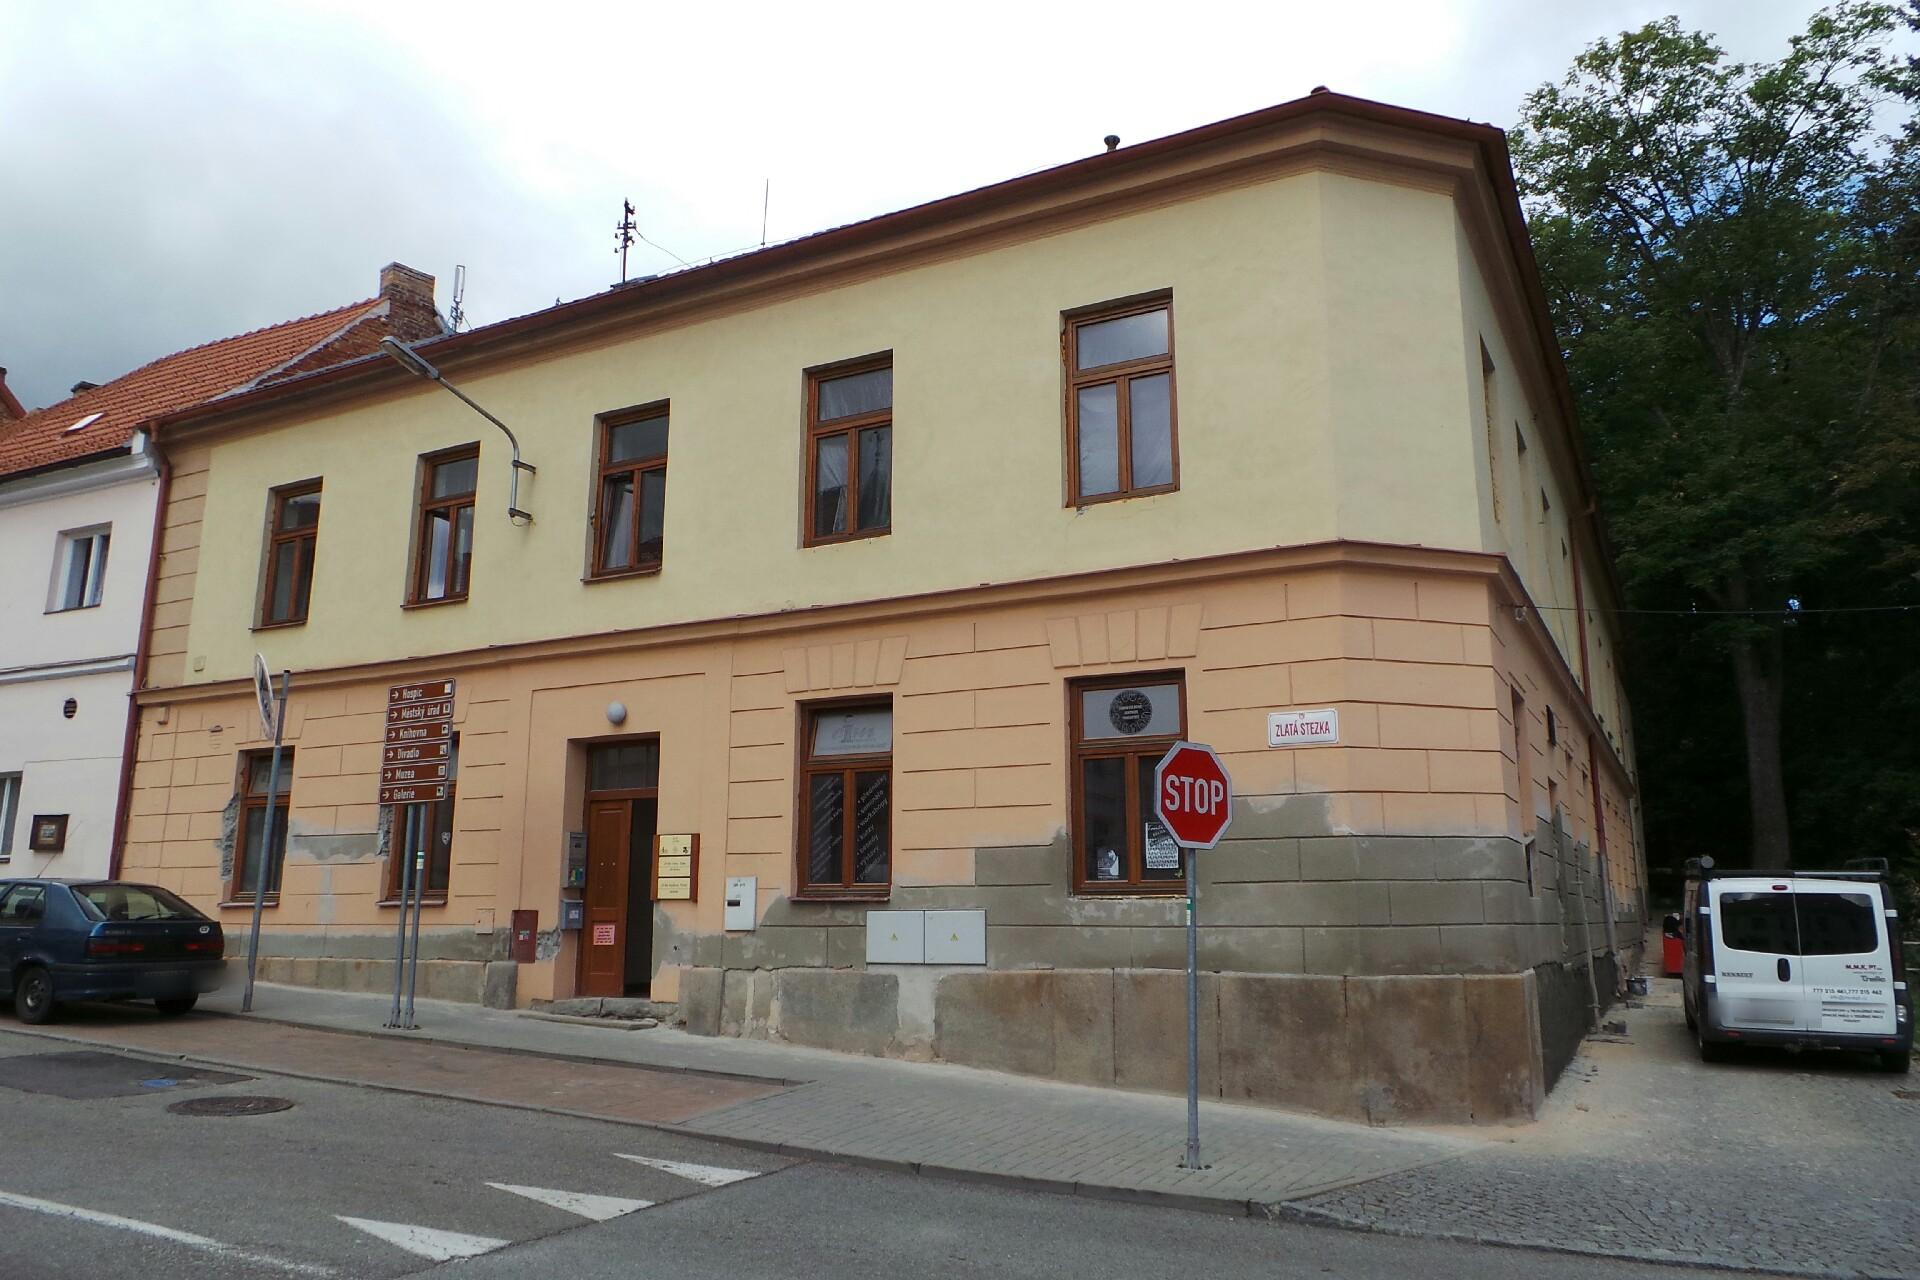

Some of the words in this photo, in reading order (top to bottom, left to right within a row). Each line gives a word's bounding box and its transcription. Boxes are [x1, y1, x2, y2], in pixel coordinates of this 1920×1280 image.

[402, 688, 423, 700] Hospic
[401, 706, 425, 719] Městský
[427, 704, 440, 716] úřad
[400, 728, 427, 739] Knihovna
[1276, 720, 1299, 737] ZLATÁ
[1300, 721, 1330, 735] STEZKA
[397, 748, 420, 759] Divadlo
[395, 768, 415, 780] Muzea
[393, 787, 415, 800] Galerie
[1165, 774, 1224, 816] STOP
